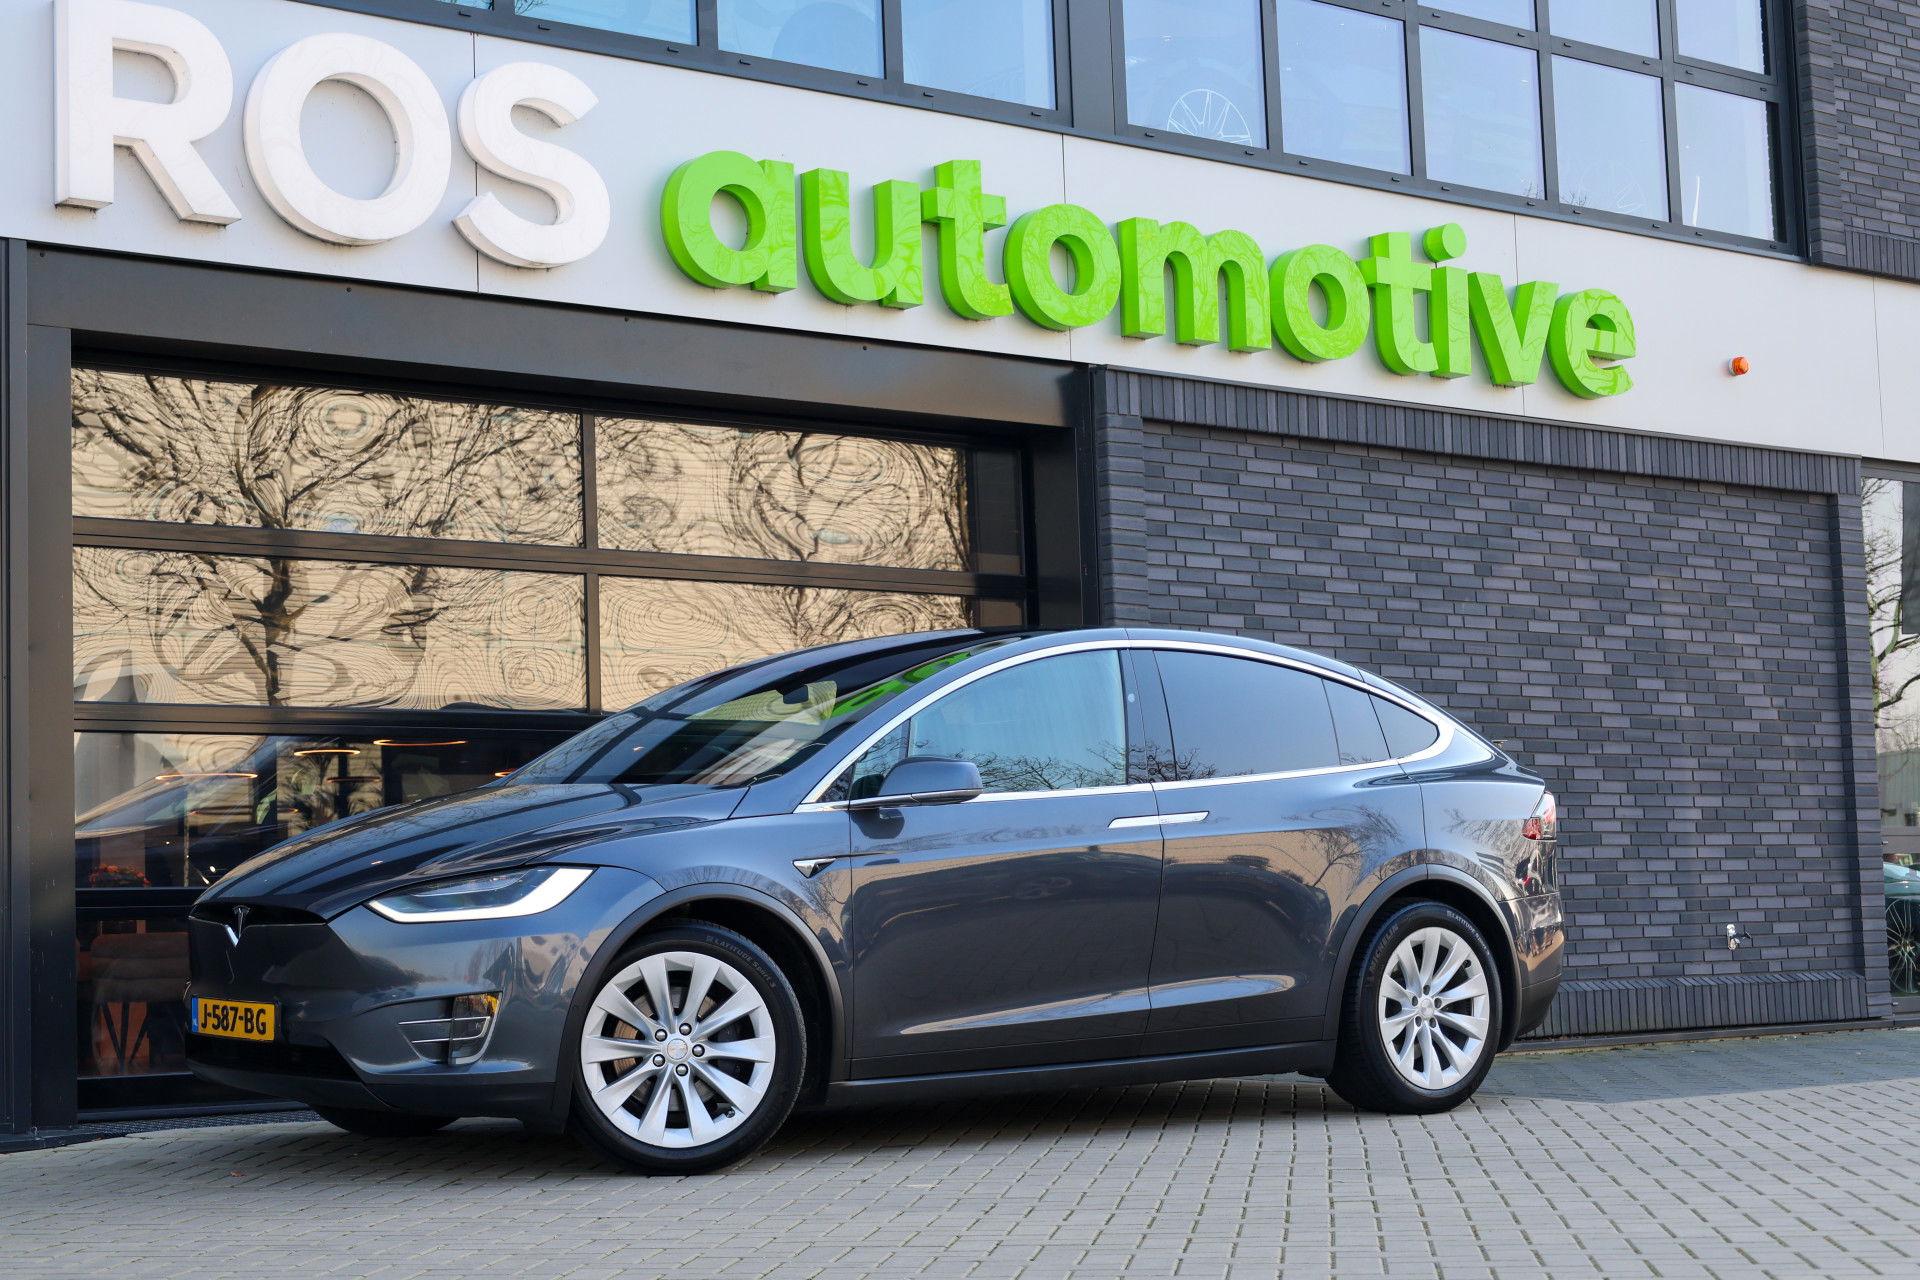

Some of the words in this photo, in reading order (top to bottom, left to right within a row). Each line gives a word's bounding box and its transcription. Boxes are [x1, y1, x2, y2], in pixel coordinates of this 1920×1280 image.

[54, 0, 611, 270] ROS
[660, 151, 1637, 398] automotive
[714, 938, 753, 963] LATITUDE
[201, 1003, 266, 1035] J-587-BG
